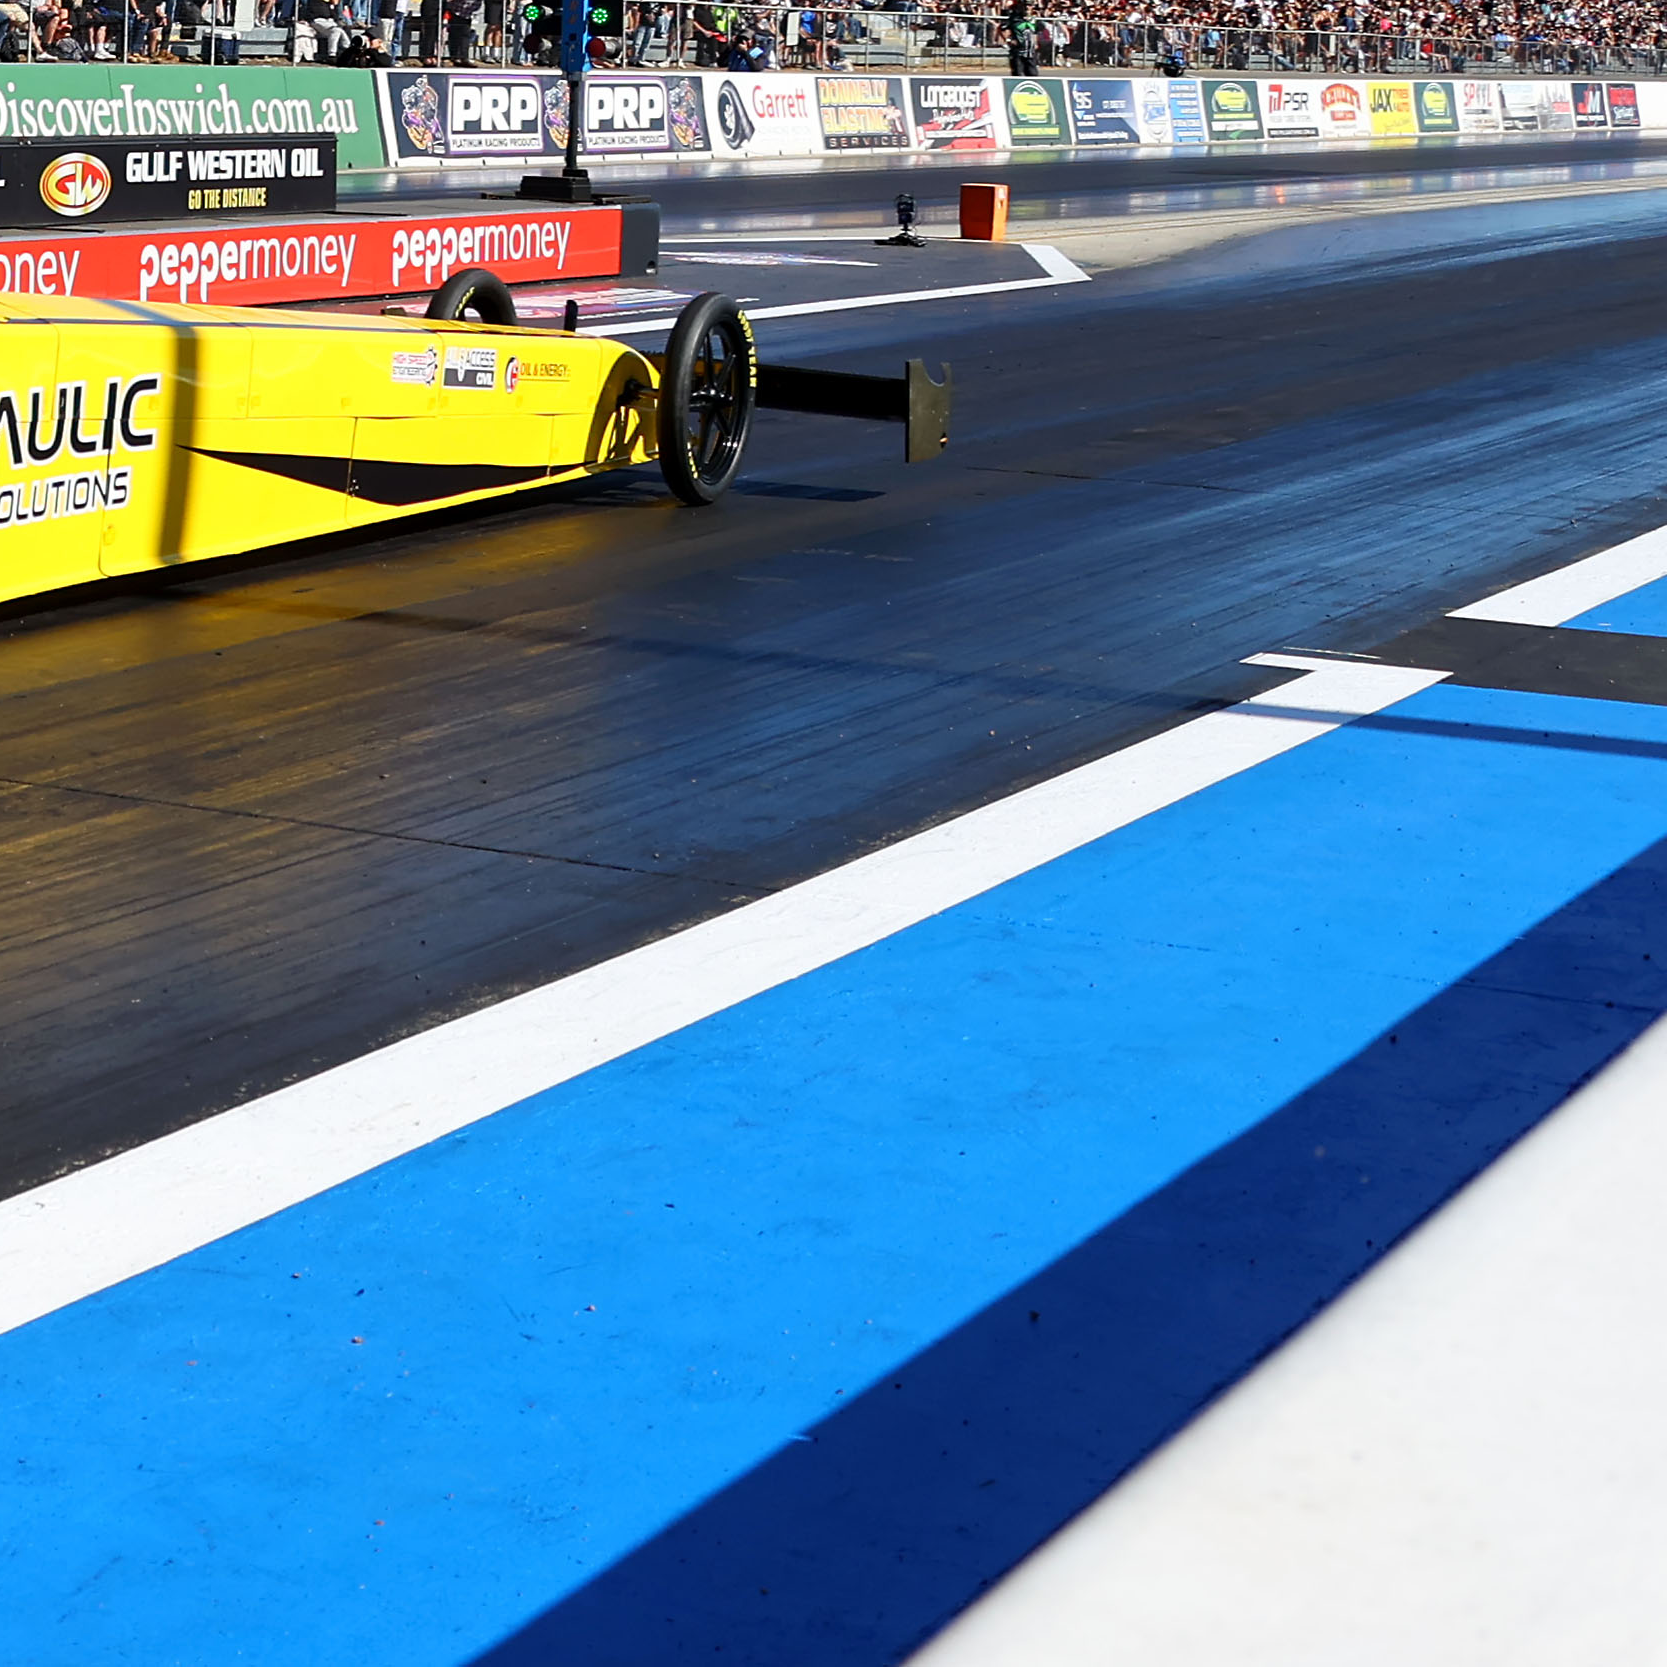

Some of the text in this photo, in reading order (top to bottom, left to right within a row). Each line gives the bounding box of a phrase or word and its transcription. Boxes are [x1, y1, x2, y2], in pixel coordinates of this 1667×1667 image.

[452, 85, 539, 132] PRP
[588, 86, 665, 132] PRP
[752, 85, 808, 119] Garrett
[1371, 88, 1393, 114] JAX
[829, 135, 908, 148] SERVICES
[125, 147, 324, 183] GULF WESTERN OIL
[188, 186, 267, 210] GO THE DISTANCE
[139, 234, 357, 304] peppermoney
[392, 221, 572, 287] peppermoney
